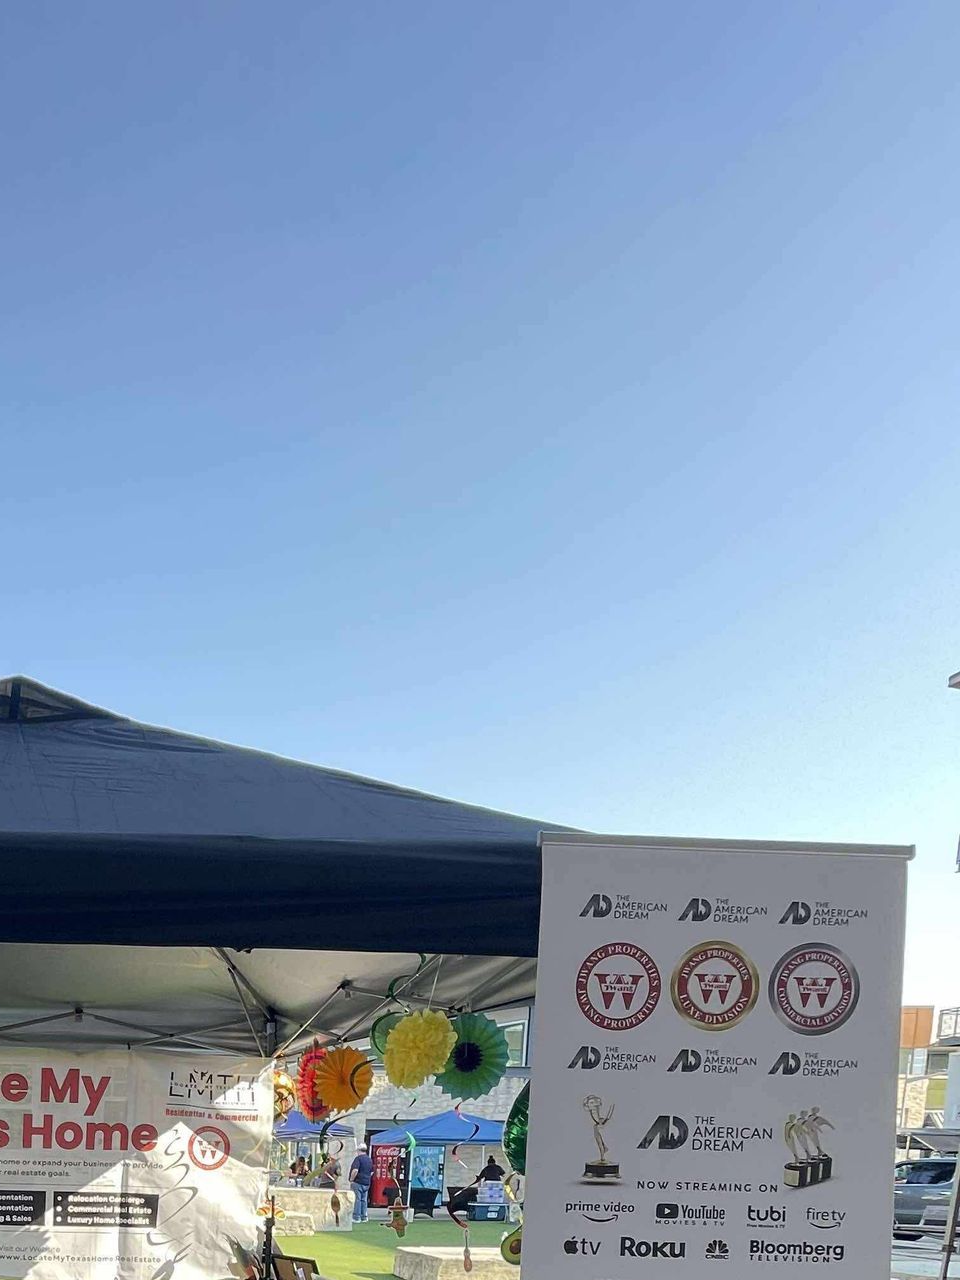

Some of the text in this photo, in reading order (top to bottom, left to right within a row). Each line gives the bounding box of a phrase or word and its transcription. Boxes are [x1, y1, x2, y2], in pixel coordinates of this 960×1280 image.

[616, 894, 630, 902] THE
[716, 898, 729, 906] THE
[614, 902, 668, 912] AMERICAN
[815, 901, 829, 909] THE
[613, 910, 649, 920] DREAM
[714, 905, 767, 916] AMERICAN
[814, 909, 868, 919] AMERICAN
[713, 913, 749, 923] DREAM
[813, 917, 849, 927] DREAM
[41, 1067, 111, 1116] My
[165, 1108, 205, 1118] Residential
[215, 1113, 258, 1122] Commercial
[695, 1116, 715, 1125] THE
[22, 1114, 158, 1151] Home
[693, 1126, 773, 1140] AMERICAN
[692, 1138, 744, 1152] DREAM
[32, 1159, 62, 1168] expand
[64, 1160, 82, 1170] your
[4, 1168, 19, 1176] real
[637, 1180, 778, 1193] NOW STREAMING ON
[68, 1205, 113, 1213] Commercial
[128, 1207, 152, 1215] Estate
[565, 1200, 635, 1214] prime video
[681, 1204, 725, 1220] YouTube
[747, 1205, 786, 1222] tubi
[67, 1216, 93, 1225] Luxury
[94, 1216, 115, 1224] Home
[578, 1238, 601, 1255] tv
[750, 1239, 845, 1261] Bloomberg
[750, 1255, 830, 1263] TELEVISION
